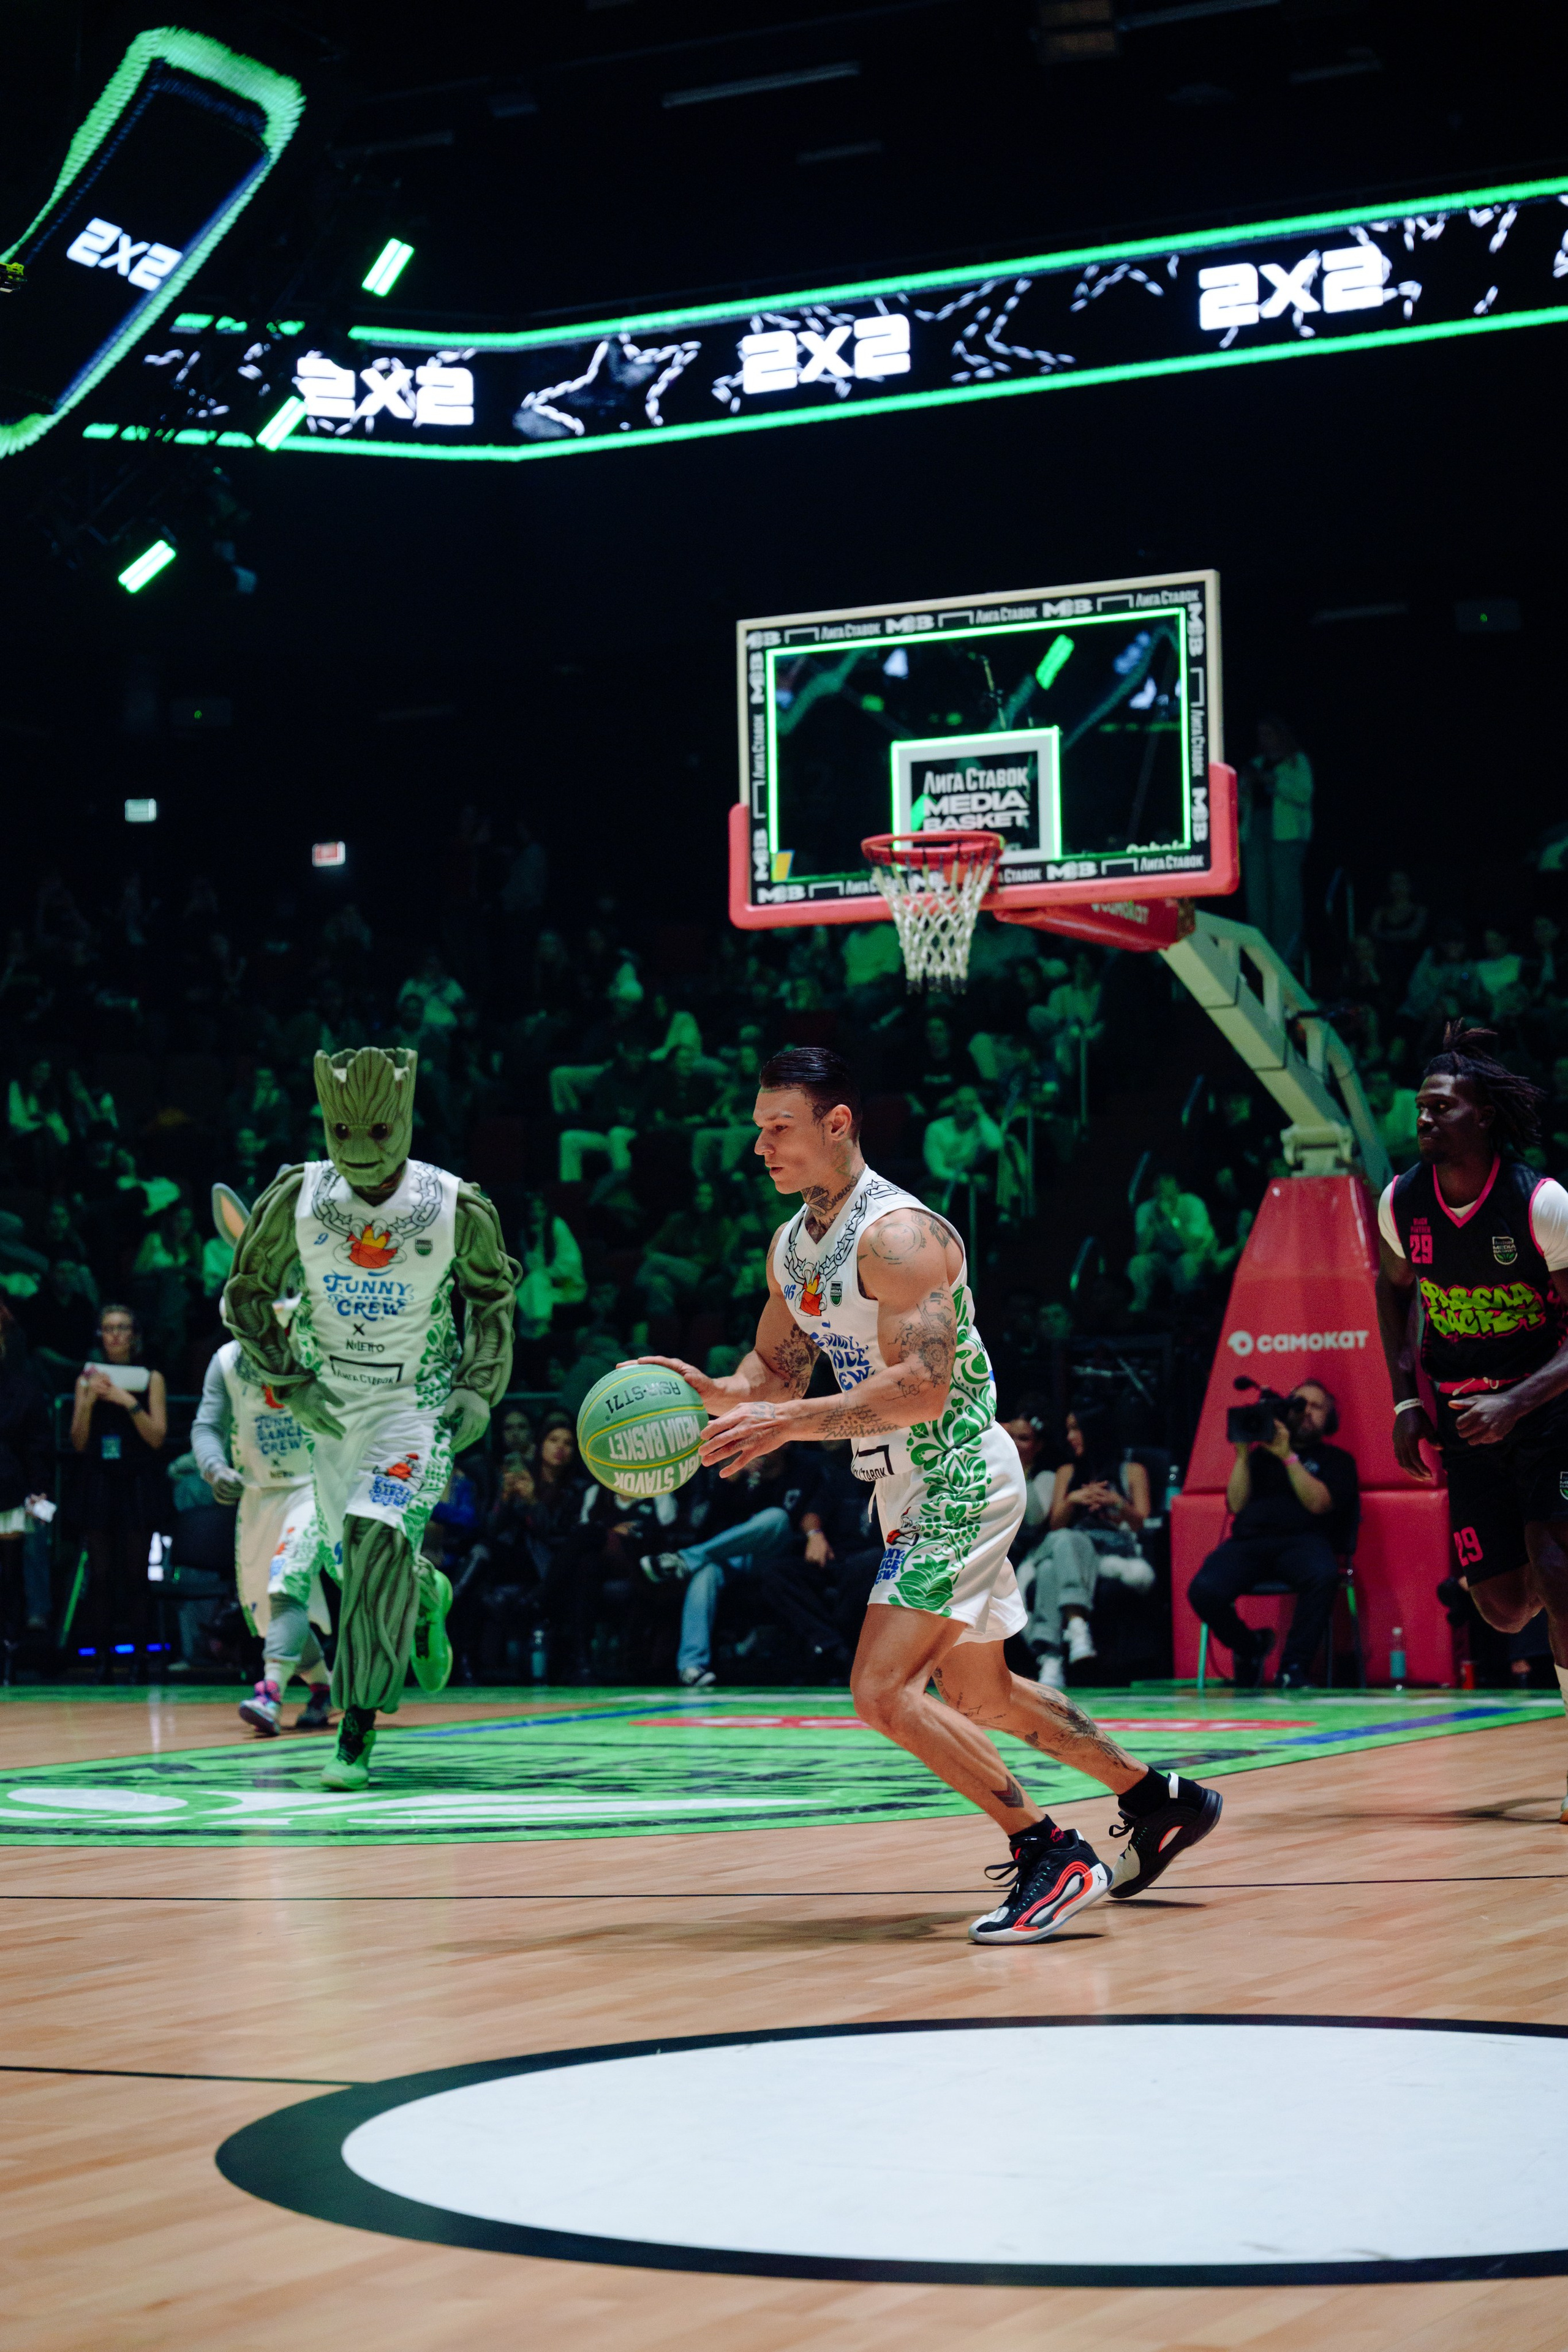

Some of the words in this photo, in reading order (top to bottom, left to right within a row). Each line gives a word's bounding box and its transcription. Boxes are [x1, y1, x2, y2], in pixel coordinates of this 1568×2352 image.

[923, 790, 1029, 816] MEDIA
[923, 810, 1030, 831] BASKET
[1409, 1234, 1433, 1264] 29
[323, 1271, 412, 1296] FUNNY
[784, 1284, 796, 1300] 96
[337, 1298, 406, 1322] CREW
[609, 1420, 666, 1461] BASKET
[660, 1415, 701, 1453] MEDIA
[613, 1466, 674, 1493] STAVOK
